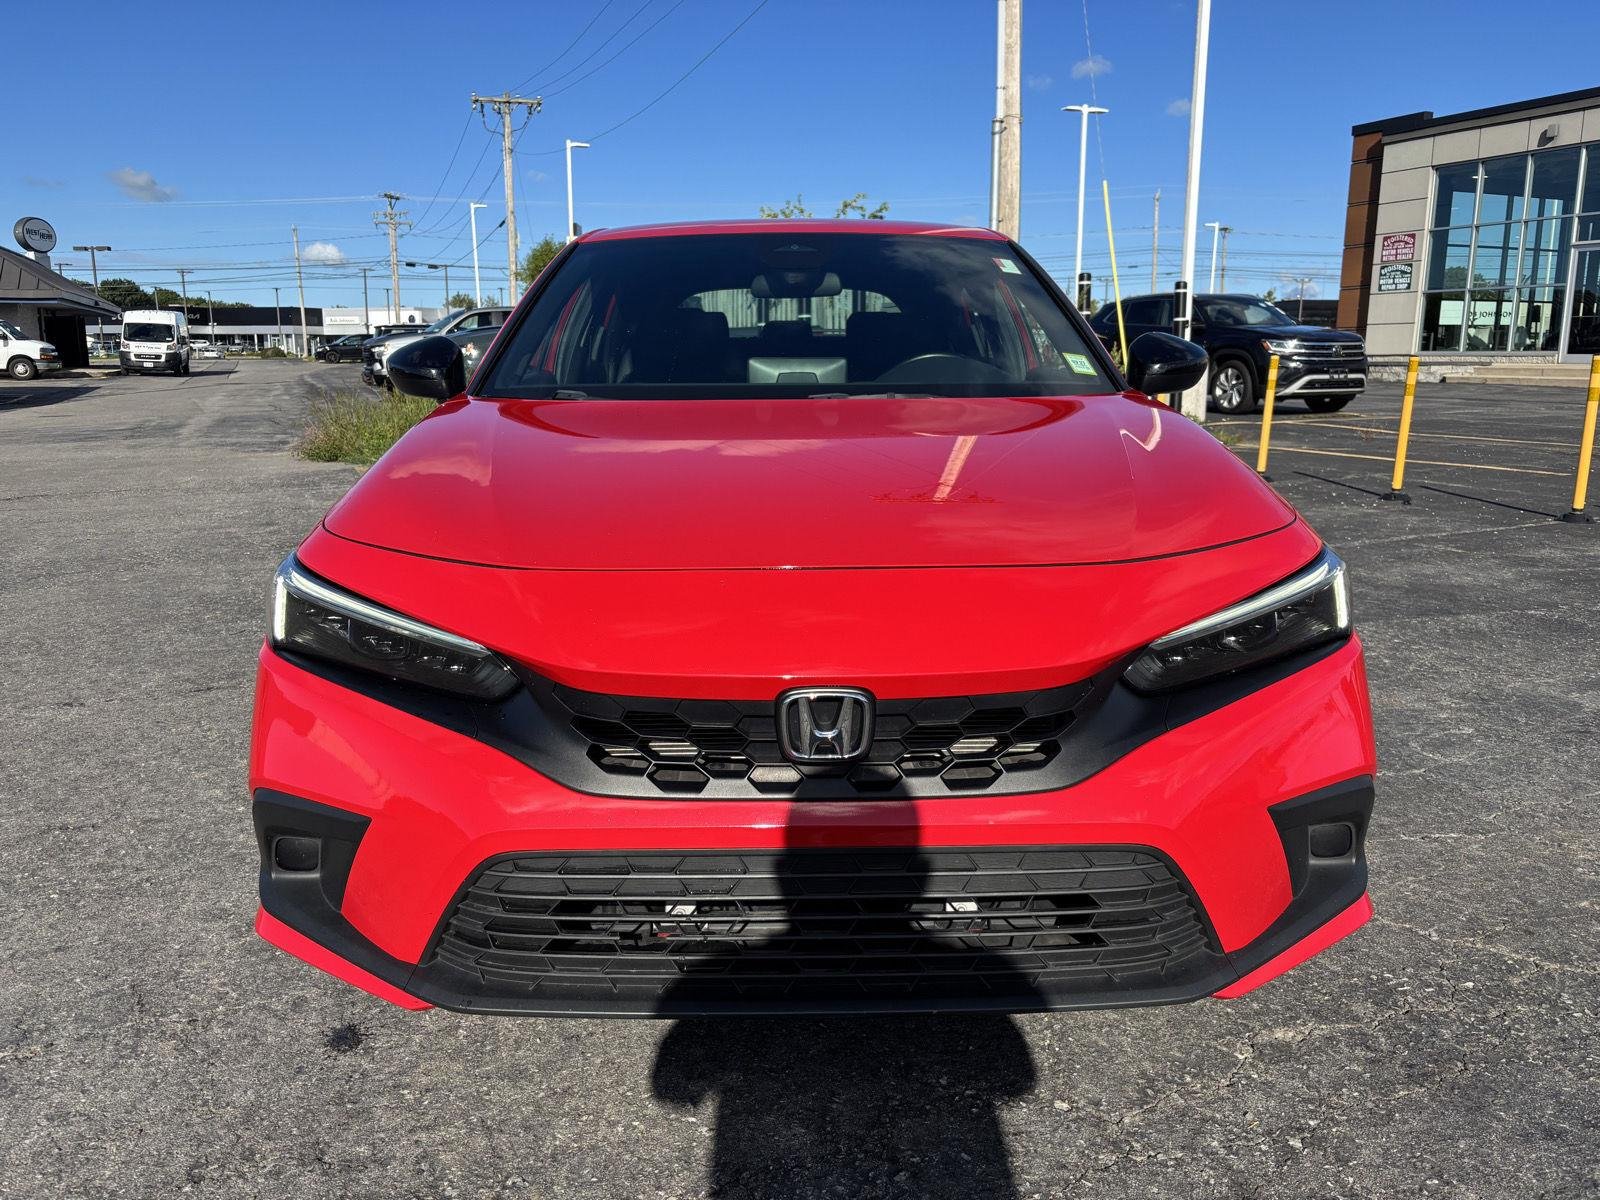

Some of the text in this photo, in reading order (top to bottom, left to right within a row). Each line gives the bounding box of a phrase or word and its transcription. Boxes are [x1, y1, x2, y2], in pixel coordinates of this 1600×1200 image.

[25, 228, 40, 236] WEST
[1383, 234, 1414, 246] REGISTERED
[1381, 264, 1412, 275] REGISTERED
